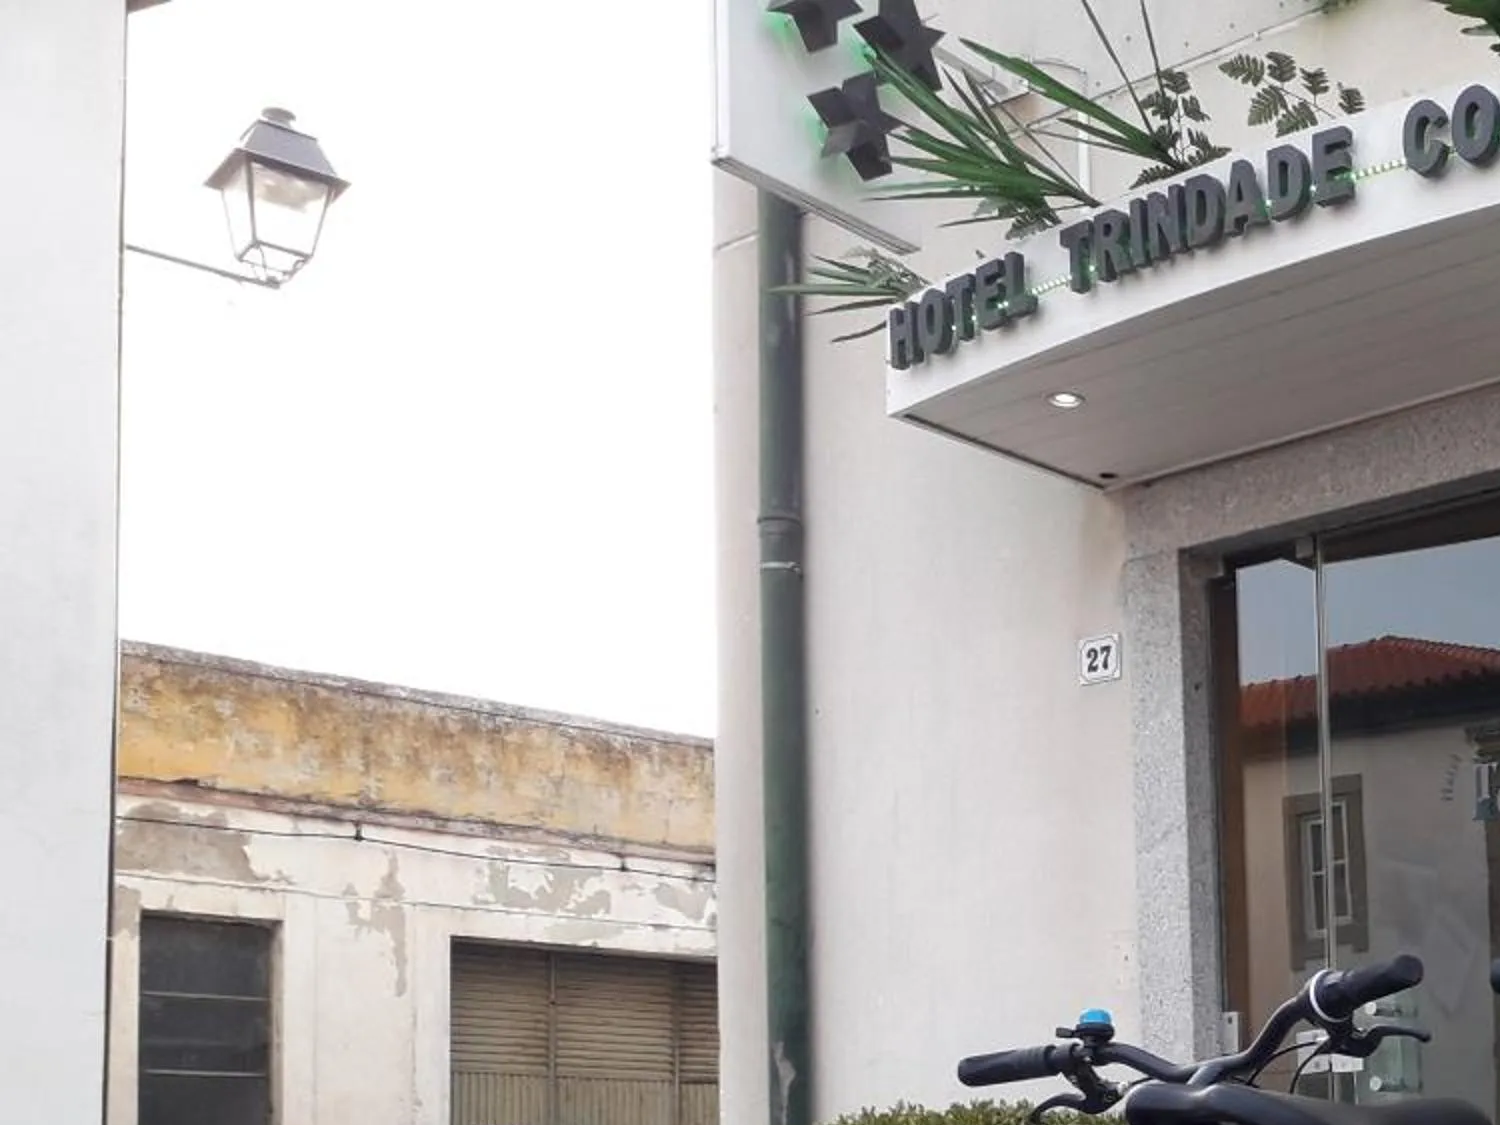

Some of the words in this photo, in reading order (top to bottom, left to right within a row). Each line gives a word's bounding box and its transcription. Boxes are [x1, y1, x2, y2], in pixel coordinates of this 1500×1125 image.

[889, 251, 1038, 370] HOTEL
[1059, 125, 1357, 295] TRINDADE
[1086, 645, 1112, 673] 27
